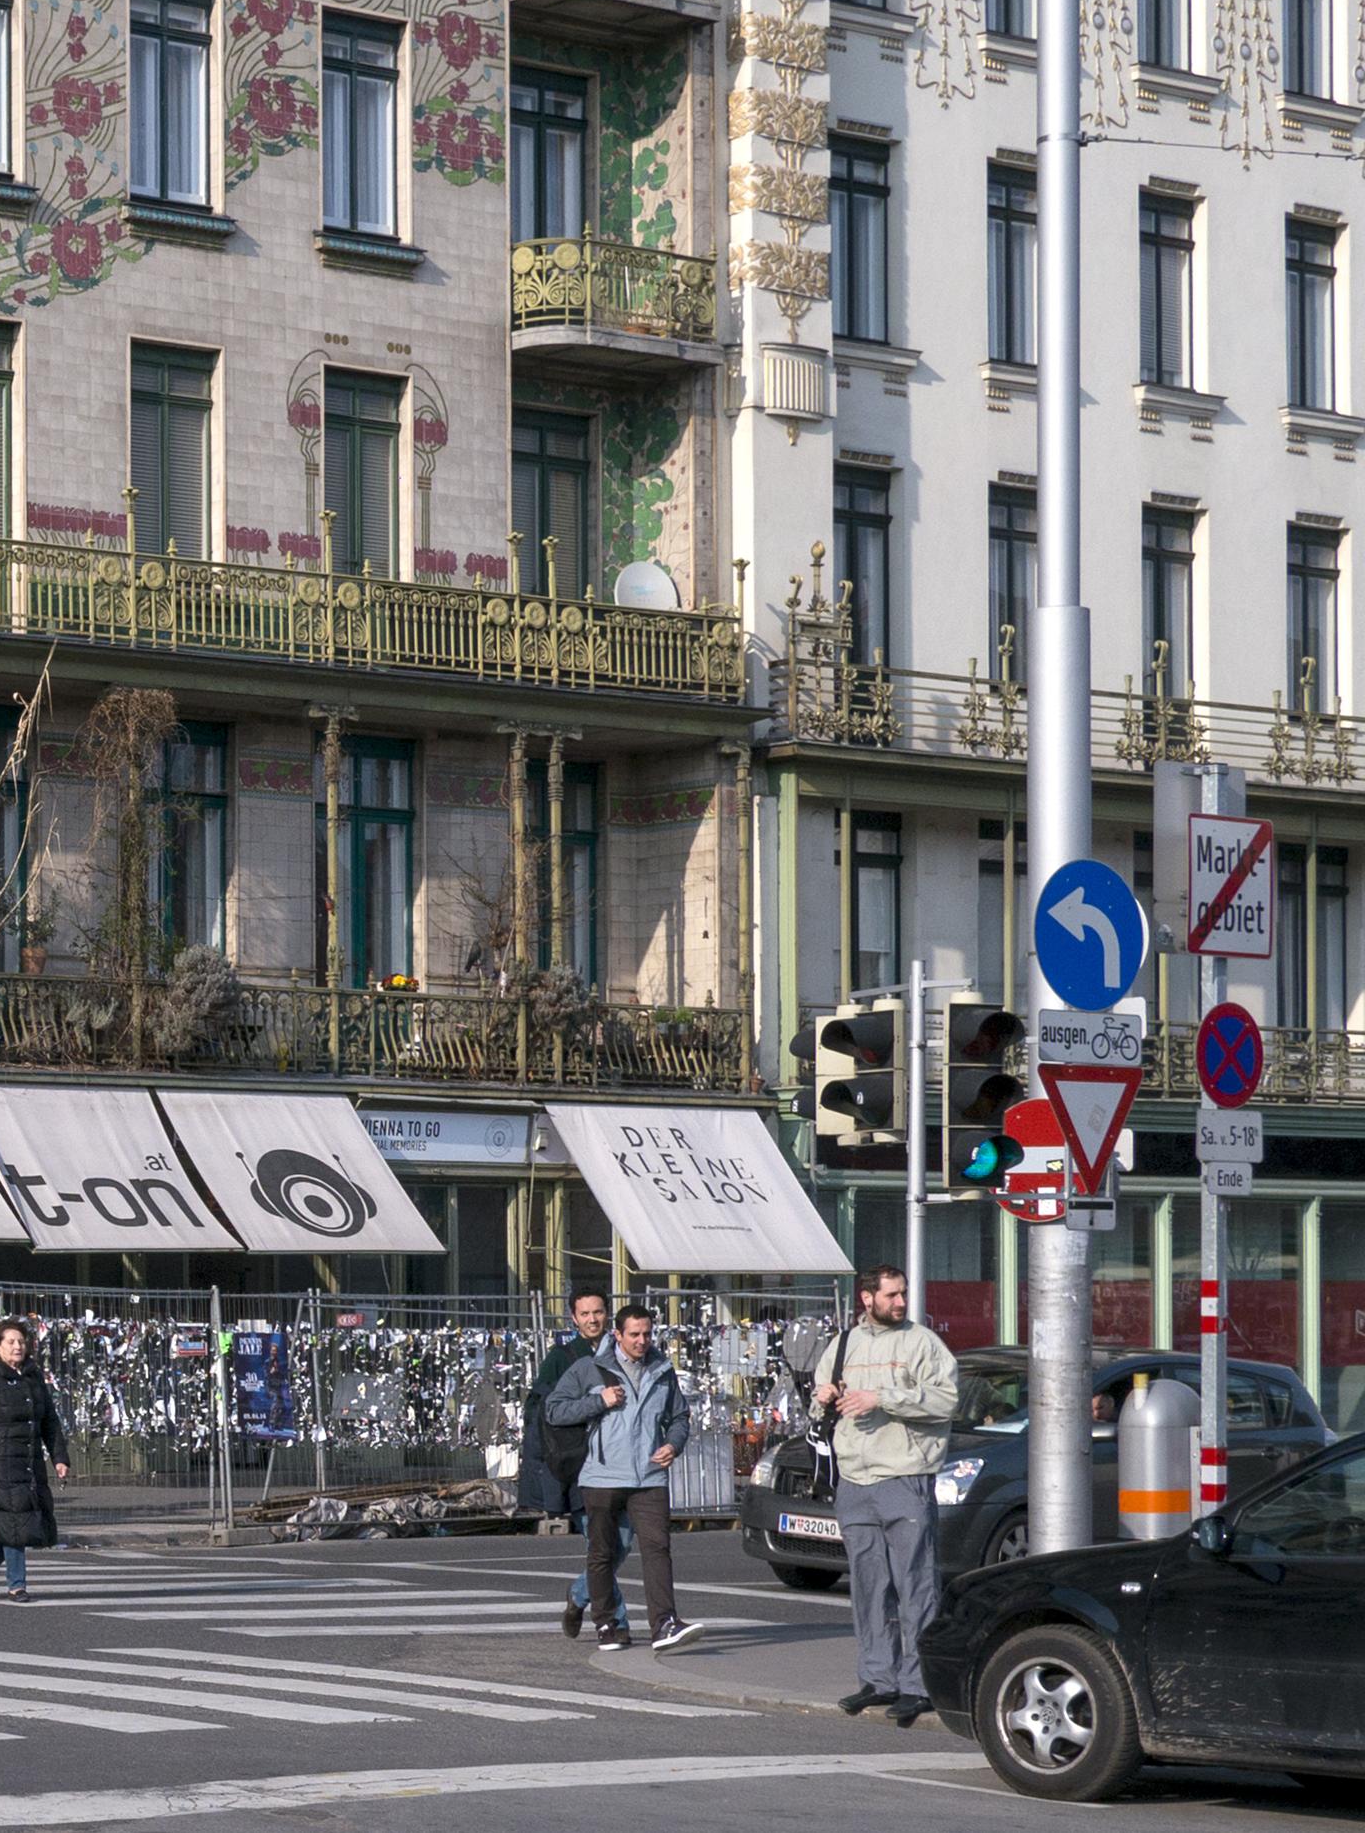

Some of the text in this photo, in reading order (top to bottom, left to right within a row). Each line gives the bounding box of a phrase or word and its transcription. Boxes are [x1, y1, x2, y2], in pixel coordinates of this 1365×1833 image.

[1197, 894, 1265, 938] gebiet
[1041, 1024, 1091, 1049] ausgen.
[408, 1120, 422, 1137] TO
[425, 1121, 441, 1138] GO
[621, 1126, 693, 1150] DER
[1200, 1126, 1217, 1145] Sa.
[390, 1139, 427, 1152] MEMORIES
[144, 1152, 173, 1172] .at
[612, 1152, 755, 1179] KLEINE
[1217, 1169, 1243, 1187] Ende
[4, 1164, 205, 1227] t-on
[653, 1177, 771, 1204] SALON
[789, 1518, 796, 1530] W
